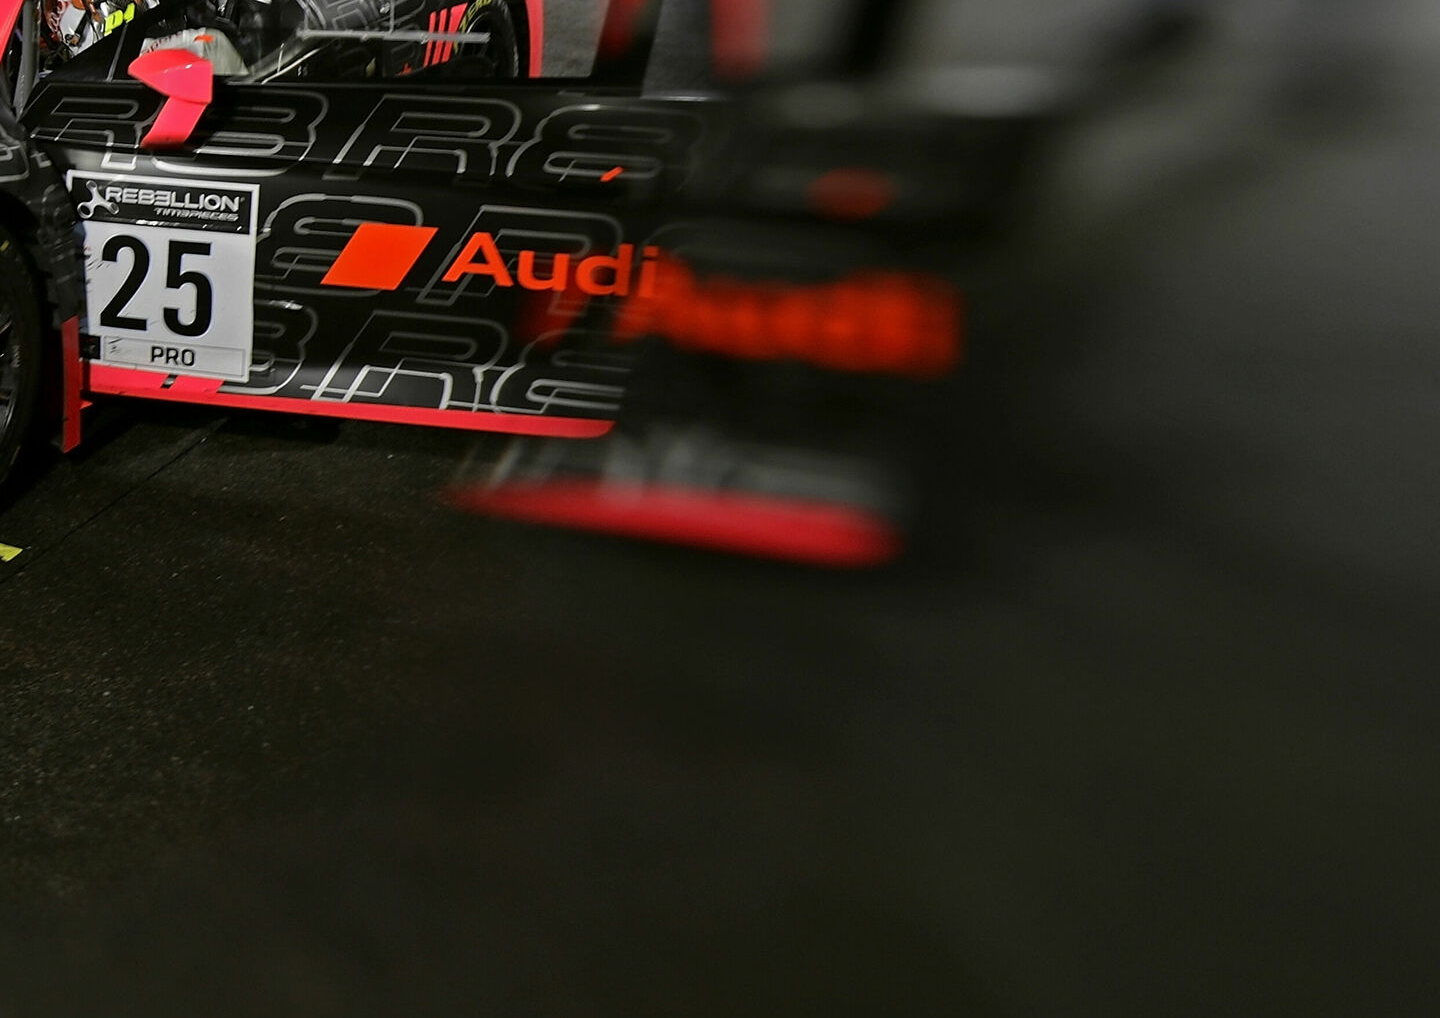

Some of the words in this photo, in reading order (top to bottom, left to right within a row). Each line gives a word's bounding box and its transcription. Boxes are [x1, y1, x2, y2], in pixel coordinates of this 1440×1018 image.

[100, 234, 213, 337] 25
[441, 231, 661, 299] Audi
[150, 345, 196, 367] PRO
